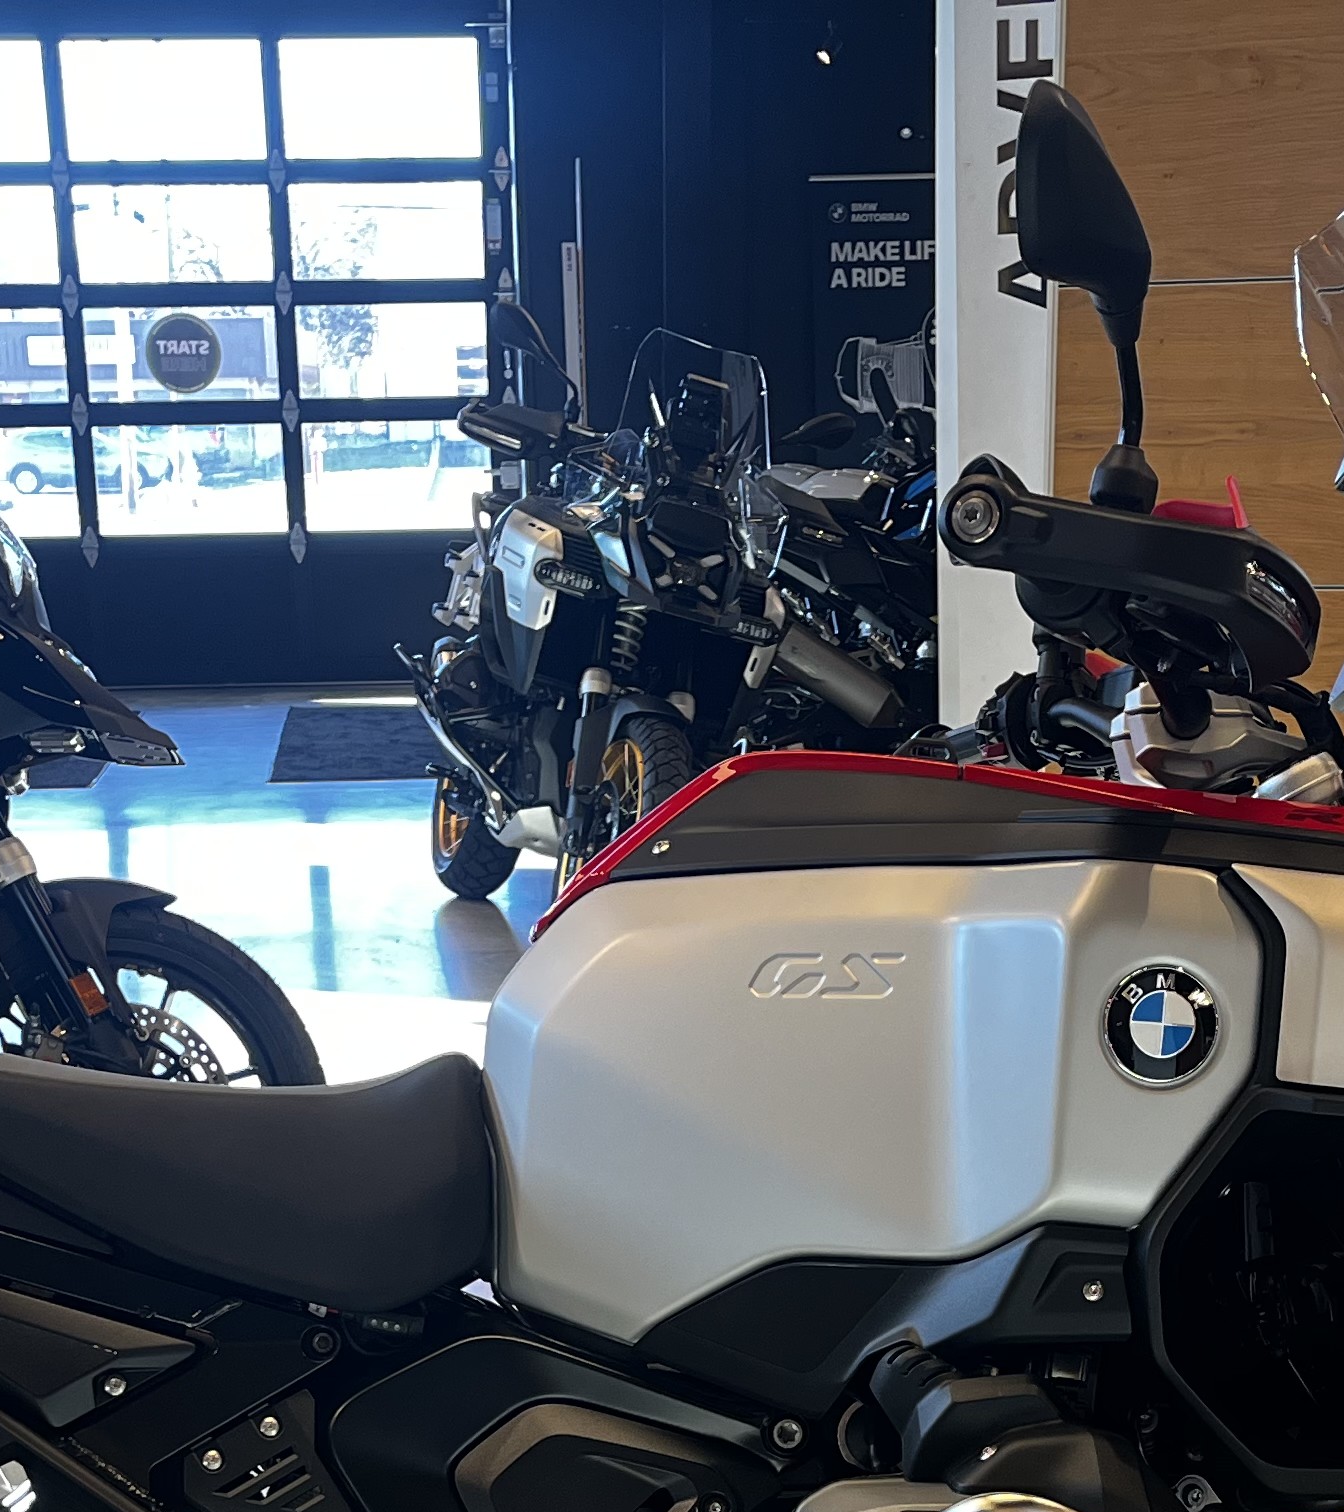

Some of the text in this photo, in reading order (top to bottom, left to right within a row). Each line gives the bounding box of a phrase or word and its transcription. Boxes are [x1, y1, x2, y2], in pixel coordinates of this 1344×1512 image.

[830, 241, 901, 262] MAKE
[830, 266, 906, 289] A RIDE
[748, 952, 906, 999] GS
[1121, 972, 1214, 1010] BMW
